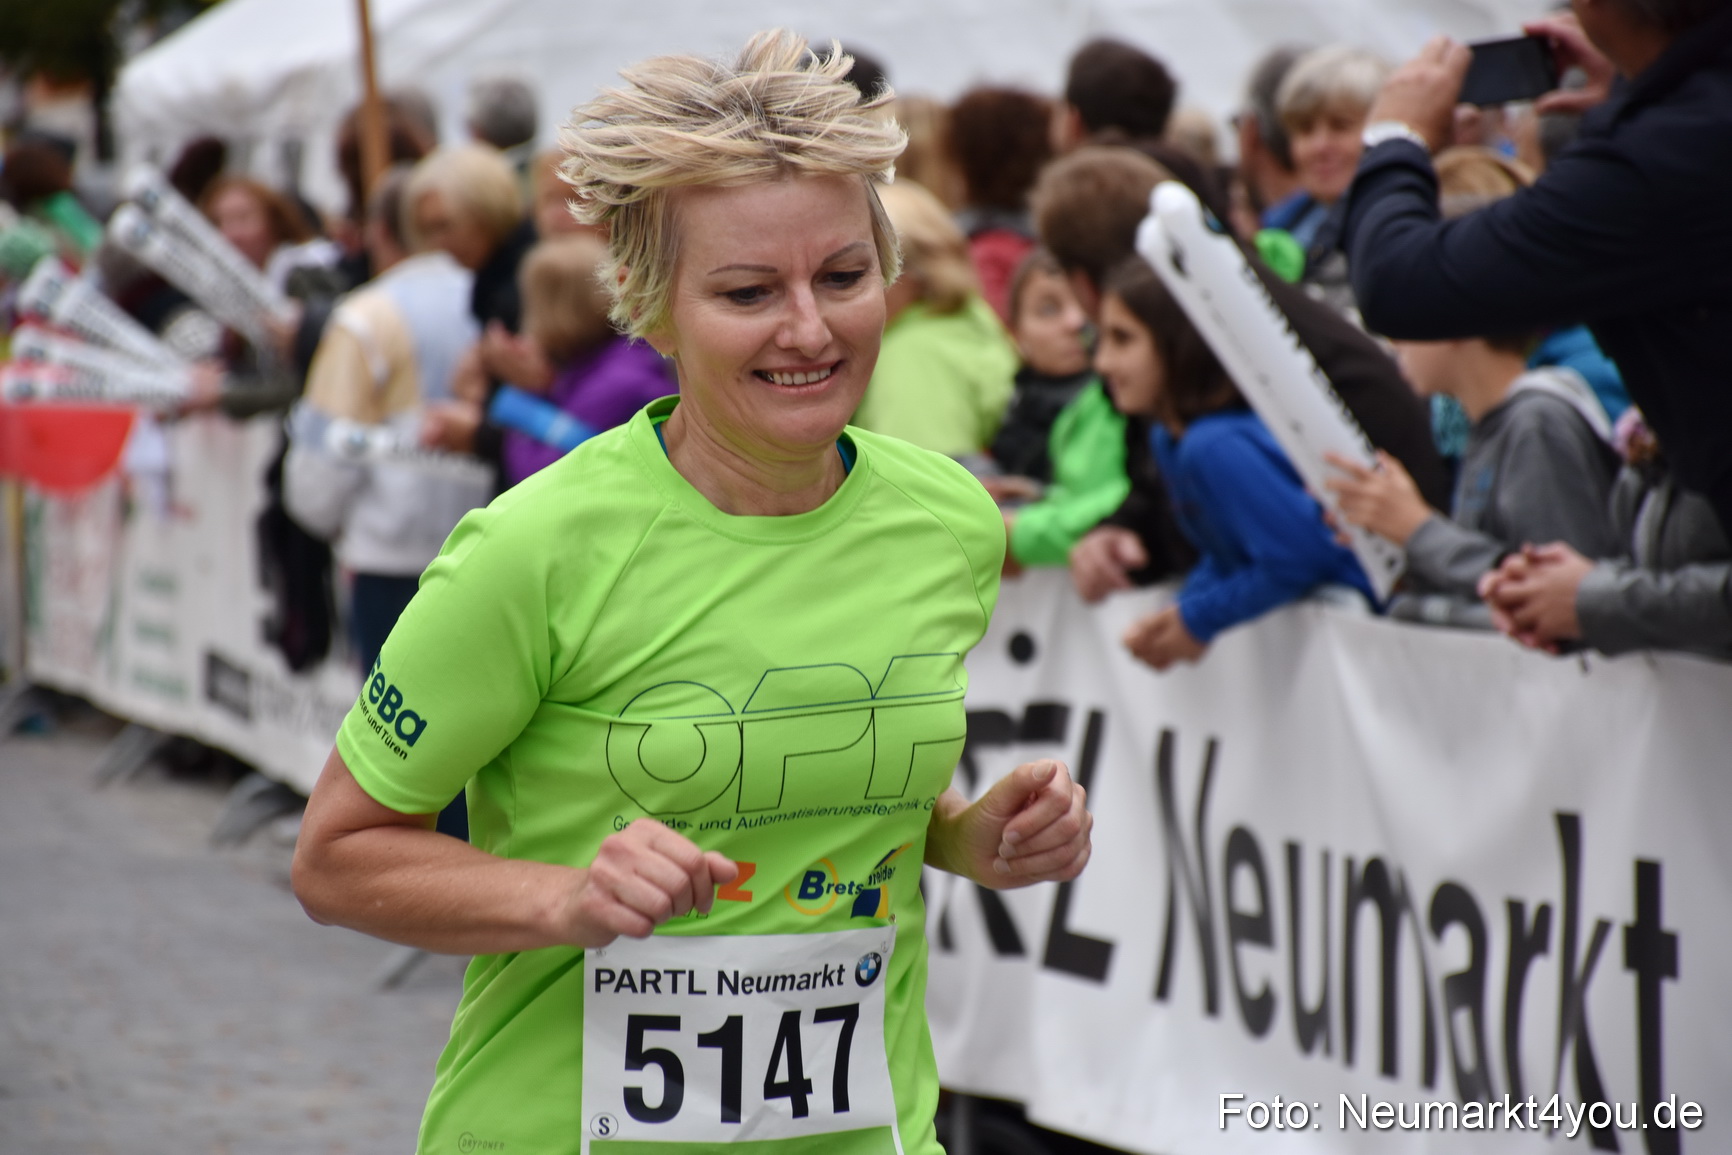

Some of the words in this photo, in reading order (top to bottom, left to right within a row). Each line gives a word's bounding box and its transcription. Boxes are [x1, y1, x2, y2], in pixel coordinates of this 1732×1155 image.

[367, 715, 383, 735] und
[380, 728, 408, 760] Türen
[700, 814, 732, 832] und
[735, 798, 921, 831] Automatisierungstechnik
[1155, 728, 1680, 1155] Neumarkt
[594, 968, 707, 995] PARTL
[717, 964, 845, 995] Neumarkt
[623, 1003, 859, 1124] 5147
[598, 1117, 611, 1135] S
